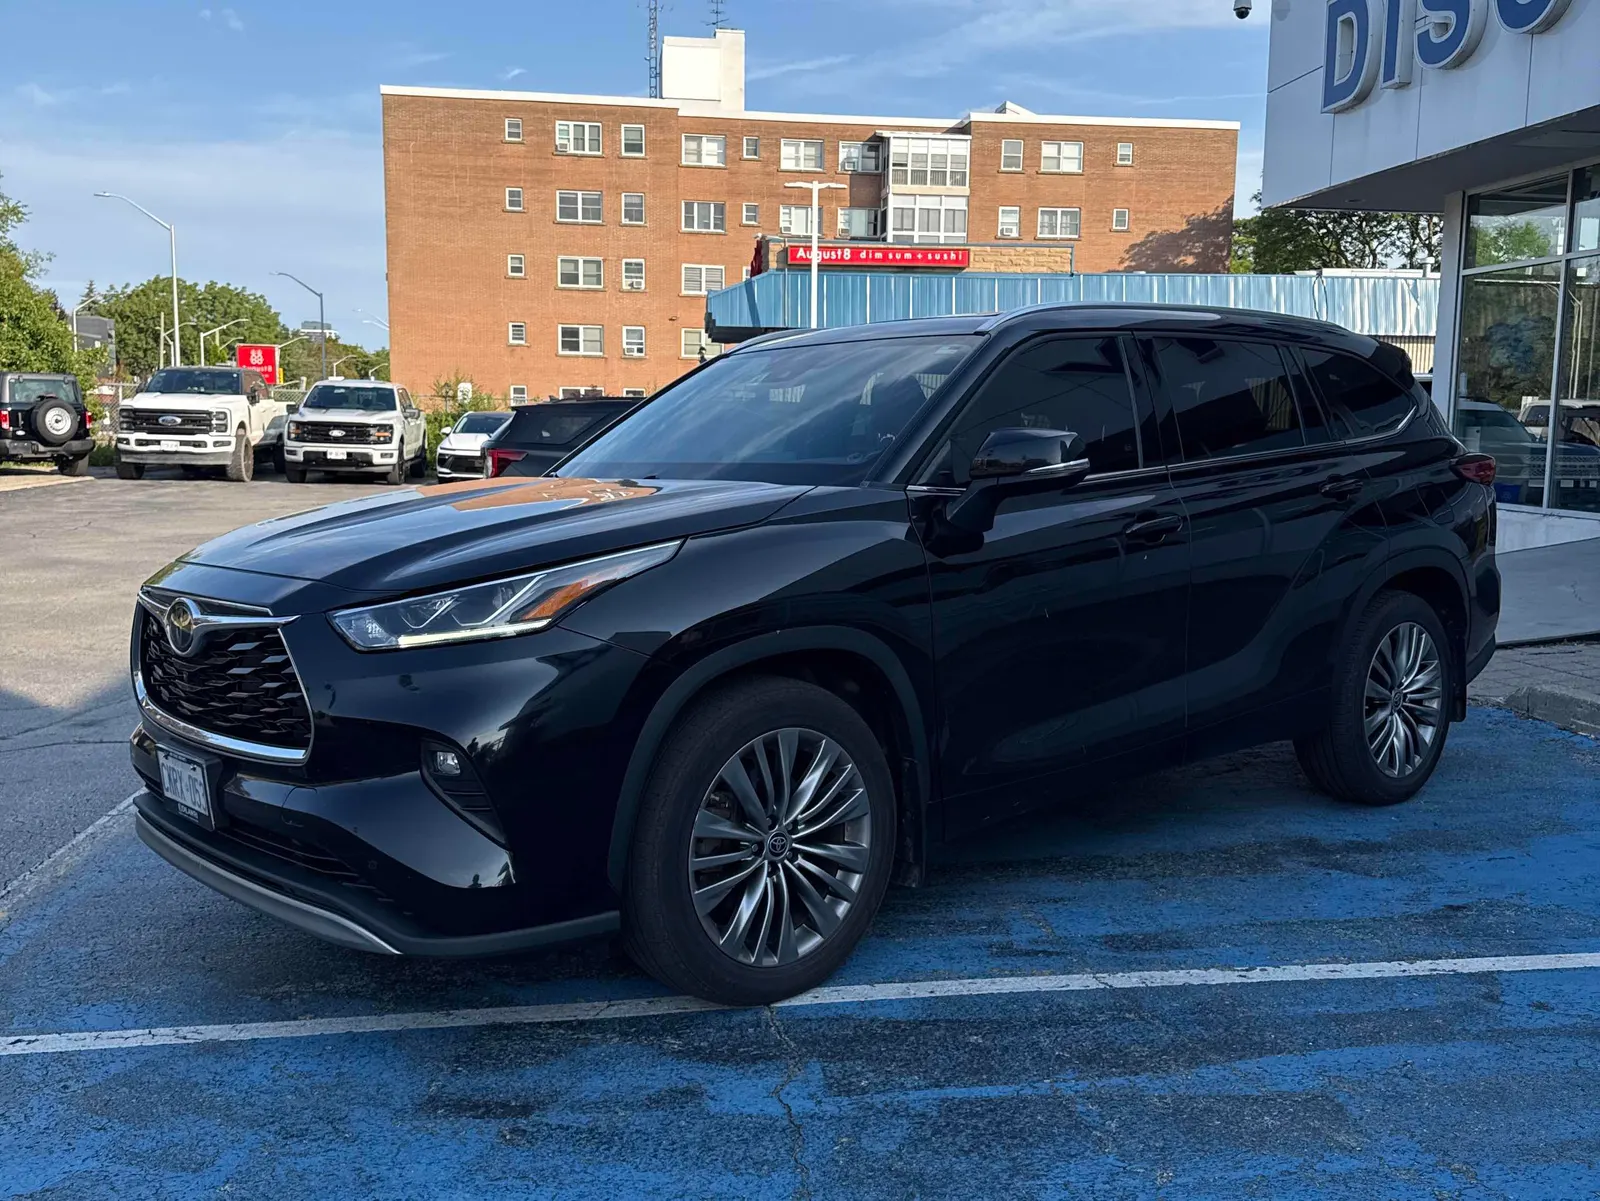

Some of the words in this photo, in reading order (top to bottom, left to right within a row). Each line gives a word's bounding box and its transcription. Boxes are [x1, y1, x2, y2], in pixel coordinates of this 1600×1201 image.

[1322, 0, 1572, 113] DIS
[796, 248, 851, 262] August8
[860, 250, 883, 259] dim
[888, 252, 912, 260] sum
[928, 251, 962, 261] sushi
